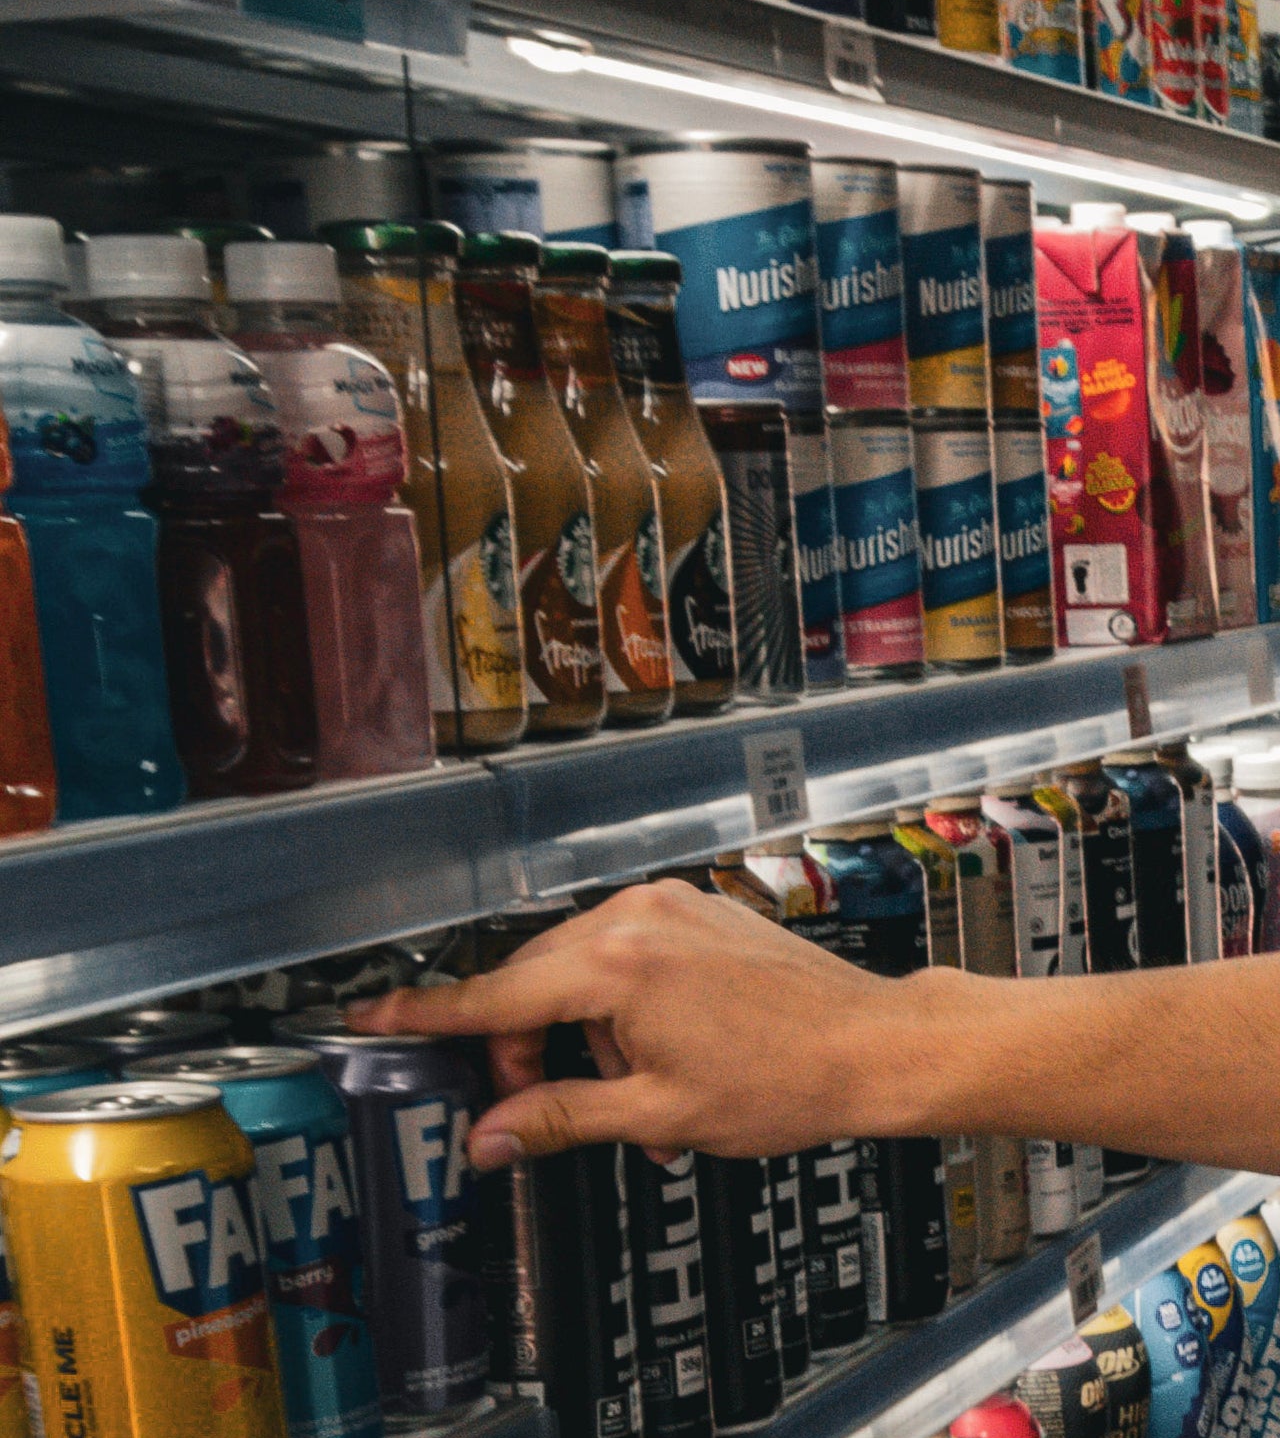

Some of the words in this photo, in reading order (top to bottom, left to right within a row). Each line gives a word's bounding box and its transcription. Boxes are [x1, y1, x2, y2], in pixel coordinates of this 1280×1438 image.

[727, 358, 768, 378] NEW
[138, 1174, 267, 1294] FA
[278, 1263, 335, 1292] berry
[52, 1325, 80, 1375] ME
